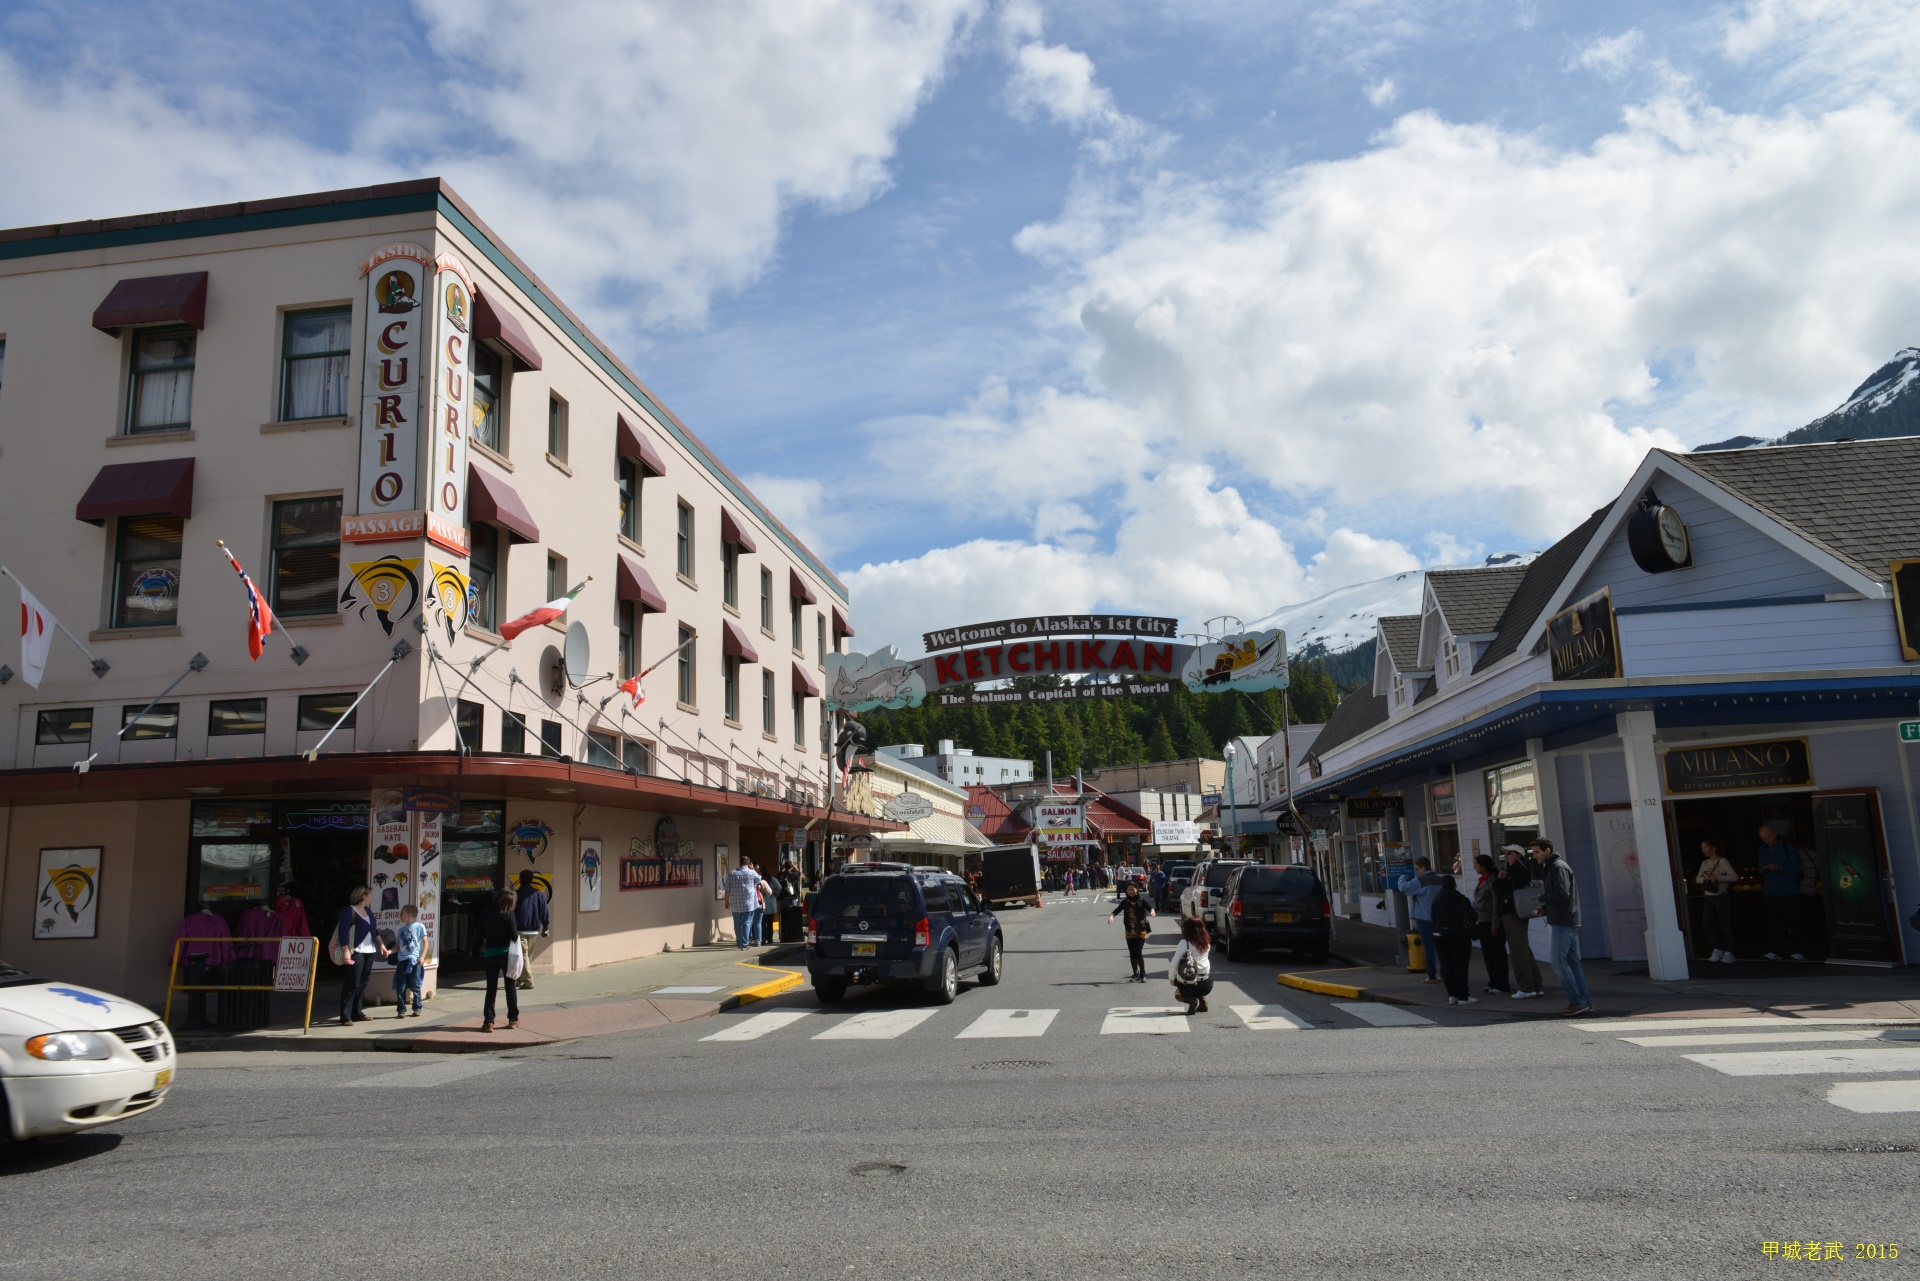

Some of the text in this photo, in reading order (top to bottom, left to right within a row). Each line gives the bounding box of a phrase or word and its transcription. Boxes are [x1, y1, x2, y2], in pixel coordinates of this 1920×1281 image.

[368, 244, 426, 267] INSIDE
[441, 254, 472, 283] INSIDE
[375, 320, 408, 503] CURIO
[440, 334, 463, 512] CURIO
[344, 516, 421, 536] PASSAGE
[429, 517, 470, 550] PASSAGE
[377, 582, 390, 601] 3
[446, 590, 456, 609] 3
[930, 616, 1171, 647] Welcome to Alaska's 1st City
[1556, 627, 1606, 675] MILANO
[934, 640, 1173, 684] KETCHIKAN
[940, 682, 1170, 705] The Salmon Capital of the World
[1680, 743, 1792, 774] MILANO
[1684, 776, 1793, 790] DIAMOND GALLERY
[1354, 799, 1398, 809] MILANO
[1437, 801, 1454, 814] DIAMOND
[1644, 798, 1656, 806] 132
[1041, 807, 1077, 816] SALMON
[1309, 814, 1332, 823] IVORY
[308, 816, 346, 824] INSIDE
[421, 822, 437, 830] SMOKED
[376, 824, 409, 834] BASEBALL
[384, 834, 402, 842] HATS
[1047, 832, 1097, 842] MARKET
[1047, 850, 1076, 859] SALMON
[625, 861, 660, 884] INSIDE
[664, 861, 700, 881] PASSAGE
[65, 883, 75, 899] 3
[421, 913, 435, 921] ALASKA
[287, 941, 305, 955] NO
[280, 956, 309, 970] PEDESTRIAN
[278, 973, 305, 986] CROSSING
